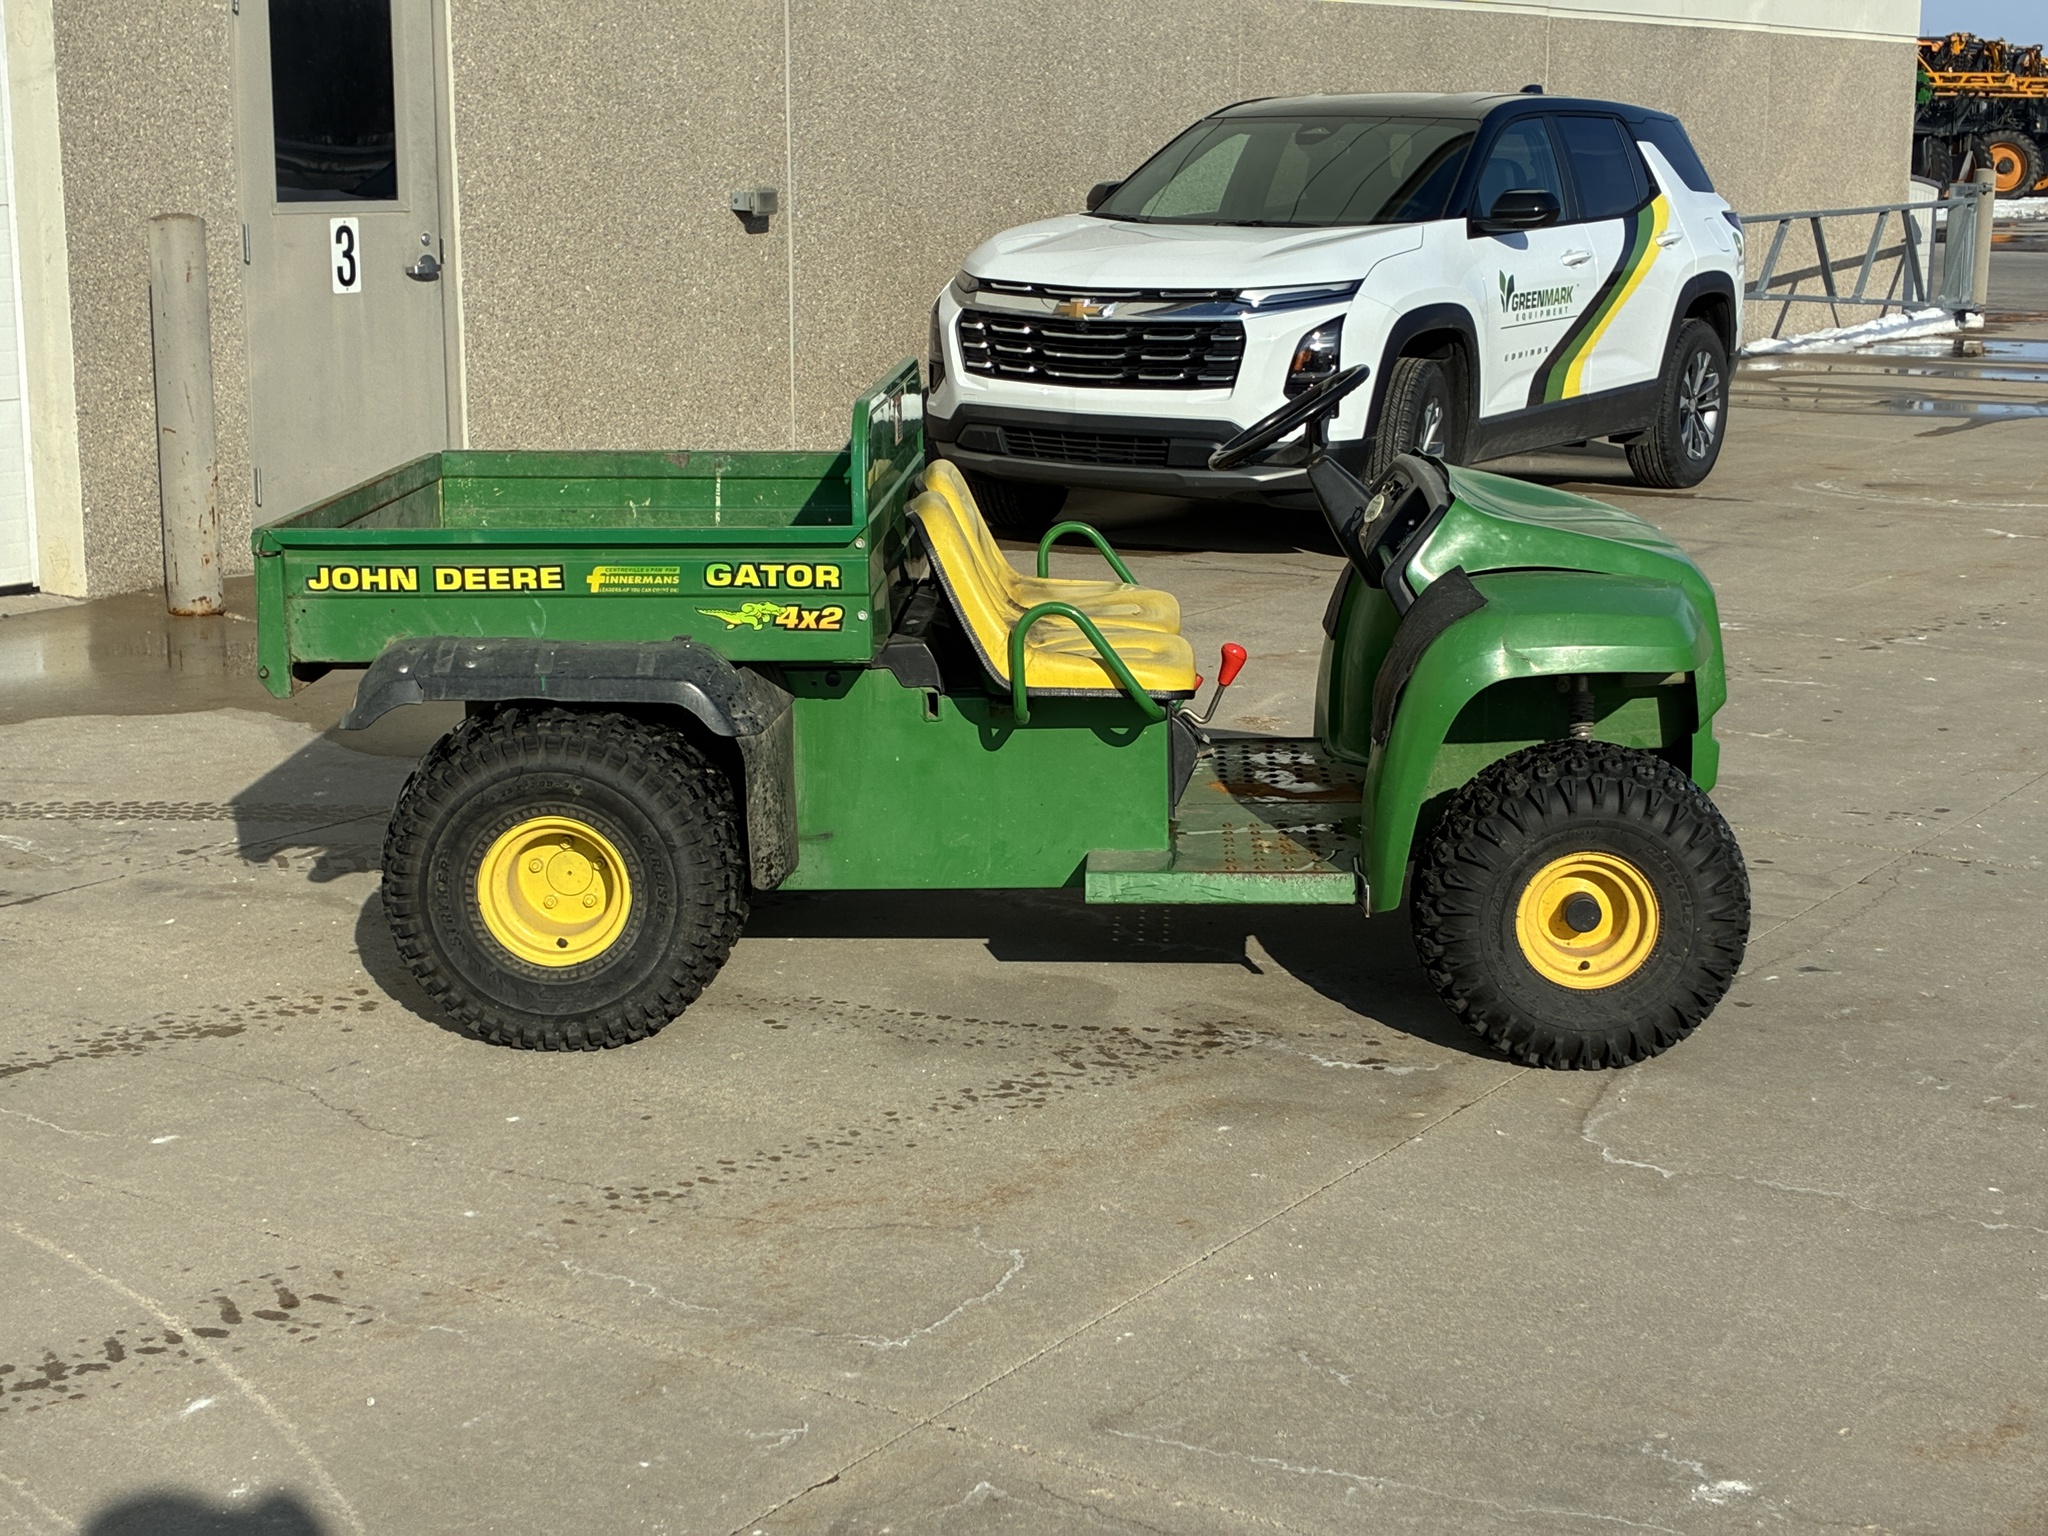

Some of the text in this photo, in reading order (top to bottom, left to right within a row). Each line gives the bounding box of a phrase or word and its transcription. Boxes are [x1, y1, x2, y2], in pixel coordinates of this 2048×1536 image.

[335, 225, 356, 287] 3
[1511, 285, 1574, 312] GREENMARK
[1515, 306, 1569, 322] EQUIPMENT
[1504, 346, 1549, 362] EQUINOX
[307, 564, 564, 592] JOHN DEERE
[704, 562, 841, 590] GATOR
[773, 604, 844, 631] 4x2
[640, 834, 668, 924] CARLISLE
[1644, 847, 1693, 926] CARLISLE
